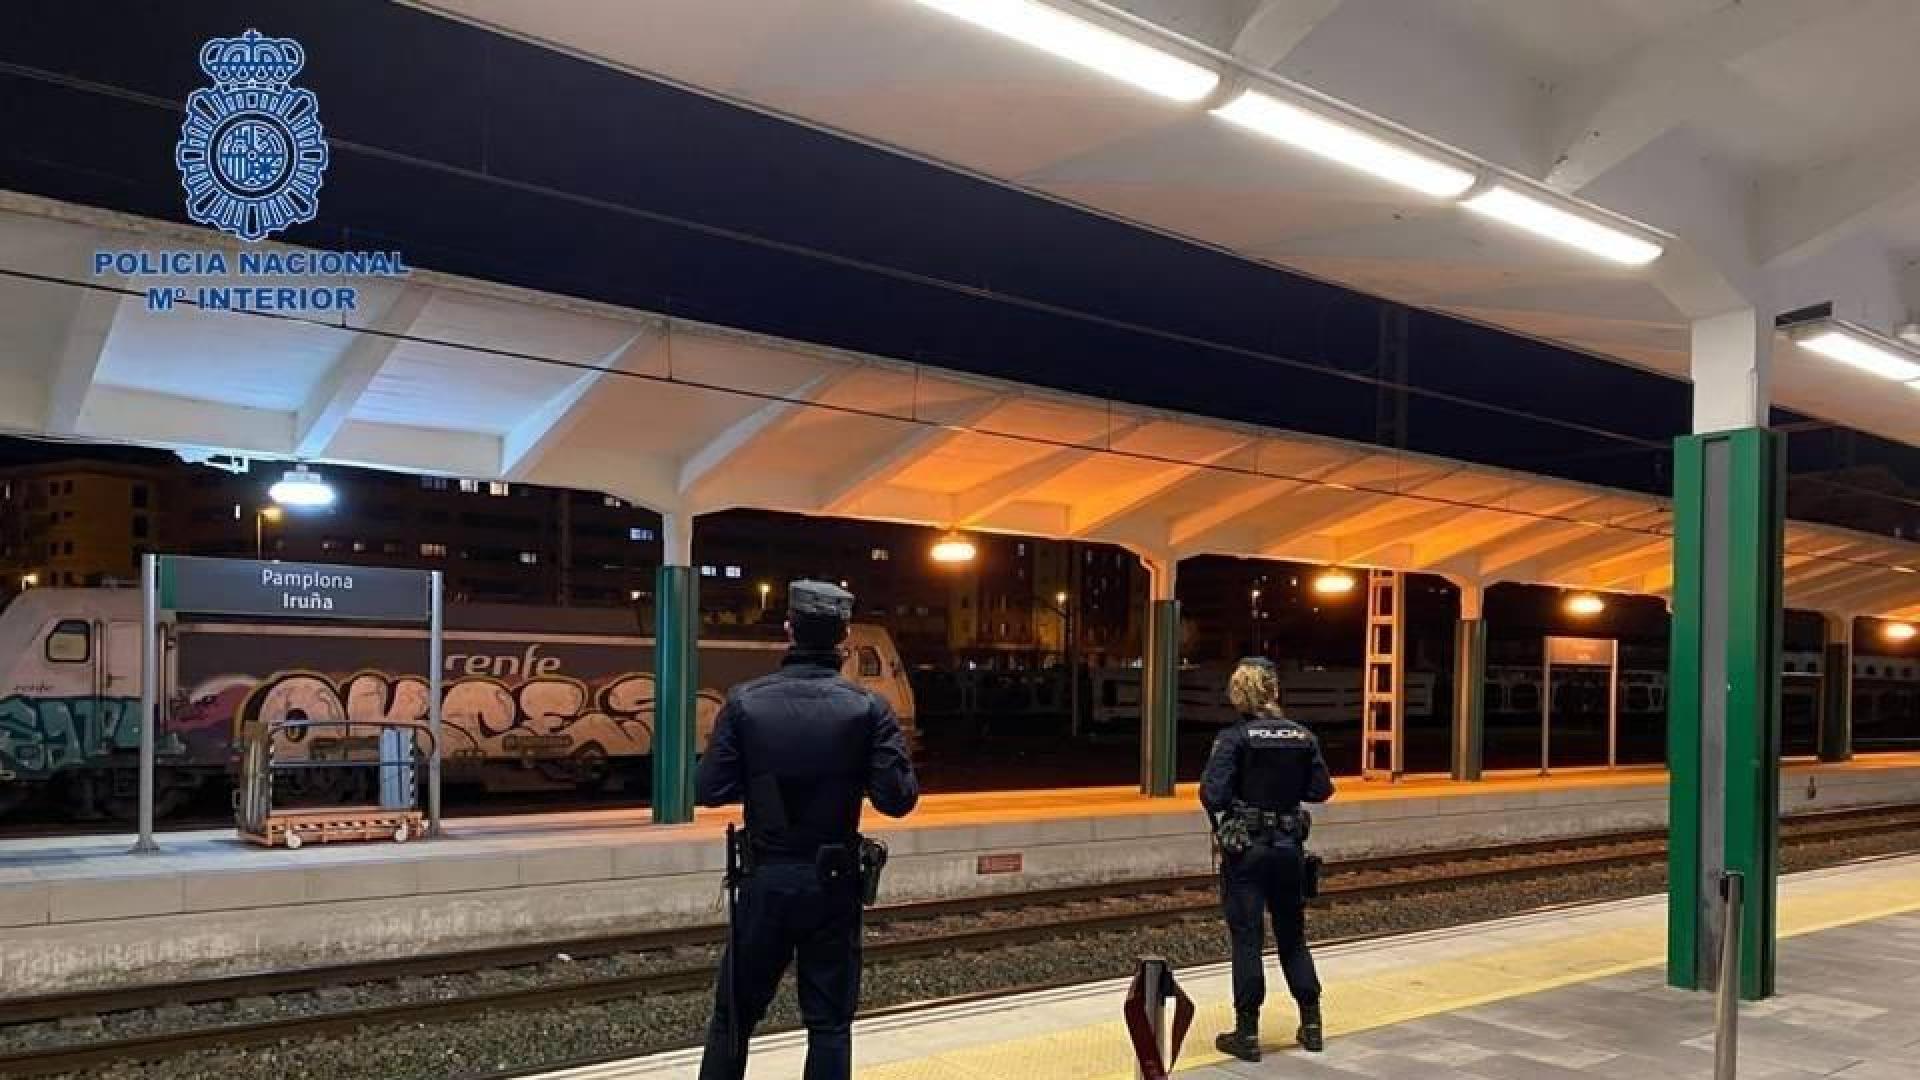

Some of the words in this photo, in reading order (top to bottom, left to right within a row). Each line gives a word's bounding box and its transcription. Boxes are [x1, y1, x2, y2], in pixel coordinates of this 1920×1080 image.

[262, 568, 353, 590] Pamplona
[283, 591, 333, 609] Iruña
[445, 644, 561, 679] renfe
